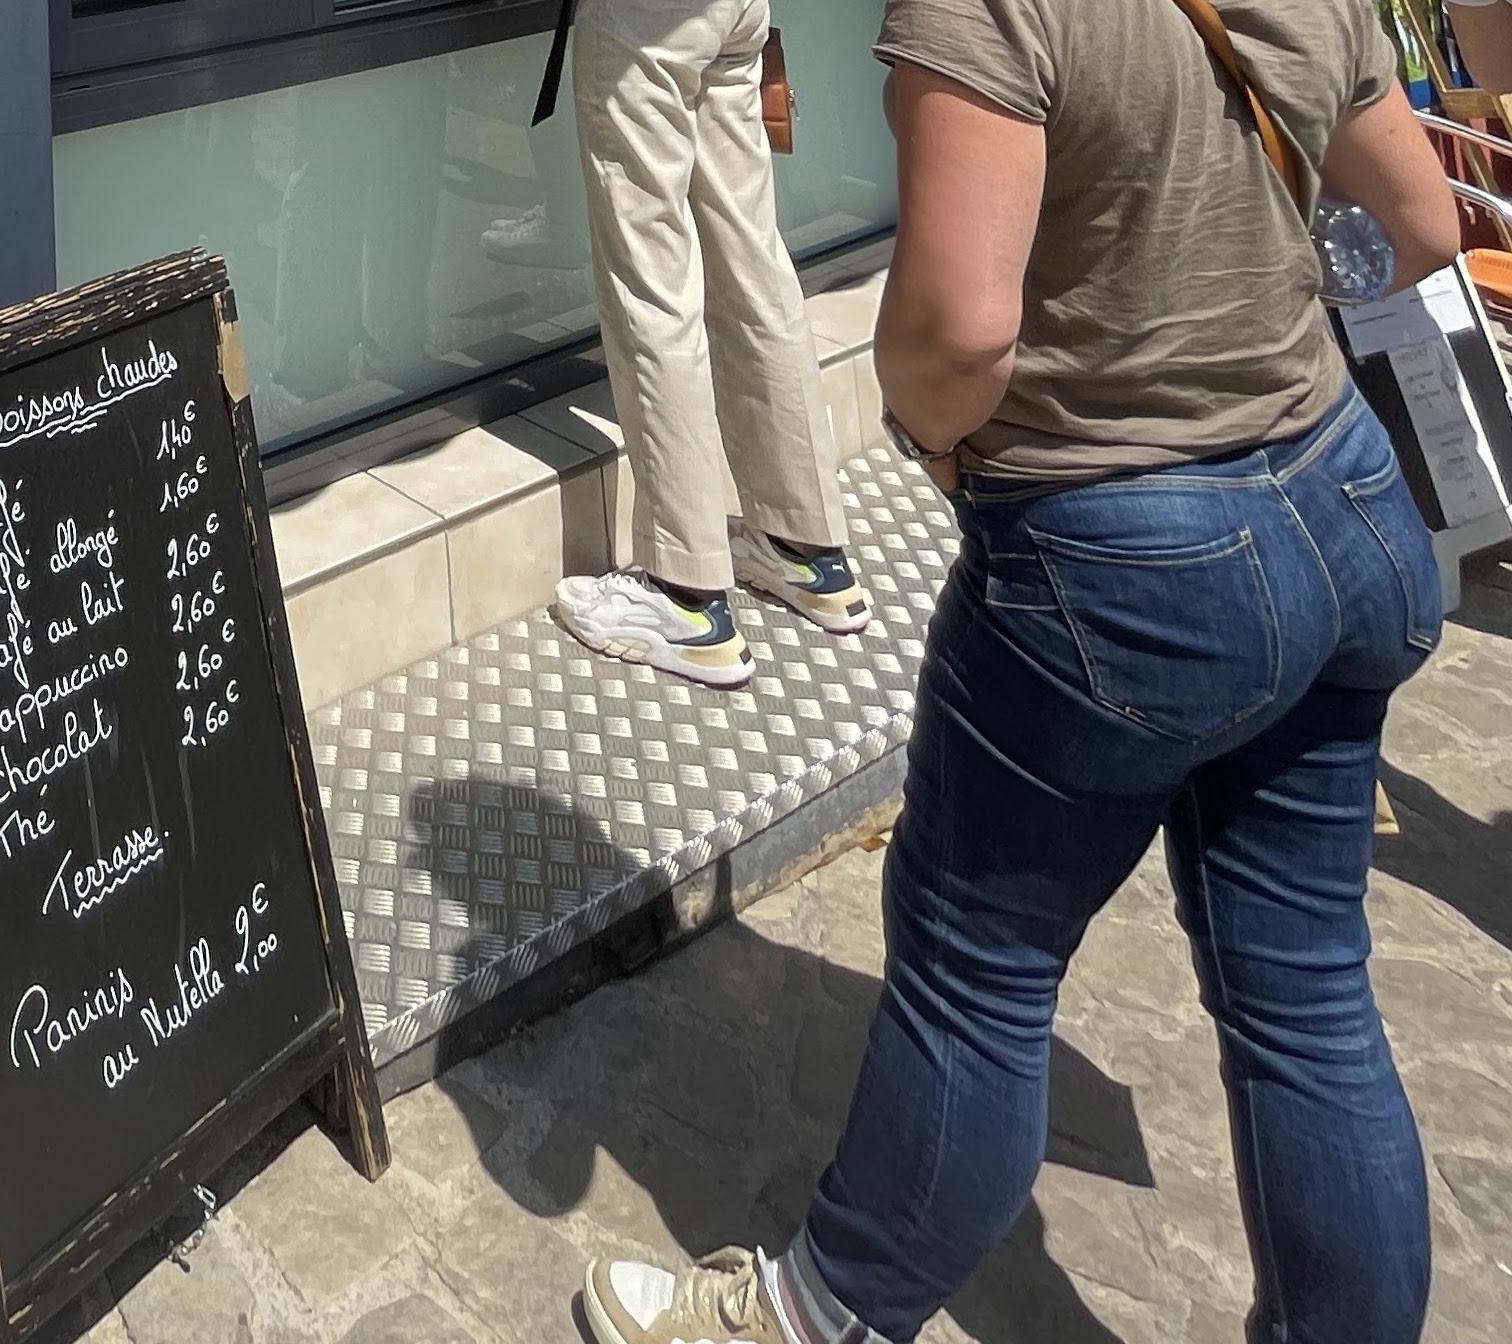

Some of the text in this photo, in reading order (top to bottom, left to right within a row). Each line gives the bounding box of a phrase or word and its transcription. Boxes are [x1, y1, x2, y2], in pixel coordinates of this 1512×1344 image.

[96, 339, 178, 399] chaudes
[50, 509, 119, 574] allongé
[47, 617, 78, 644] au
[81, 571, 125, 626] lait
[9, 967, 134, 1068] Paninis
[102, 1043, 140, 1089] au
[139, 936, 225, 1047] Nutella
